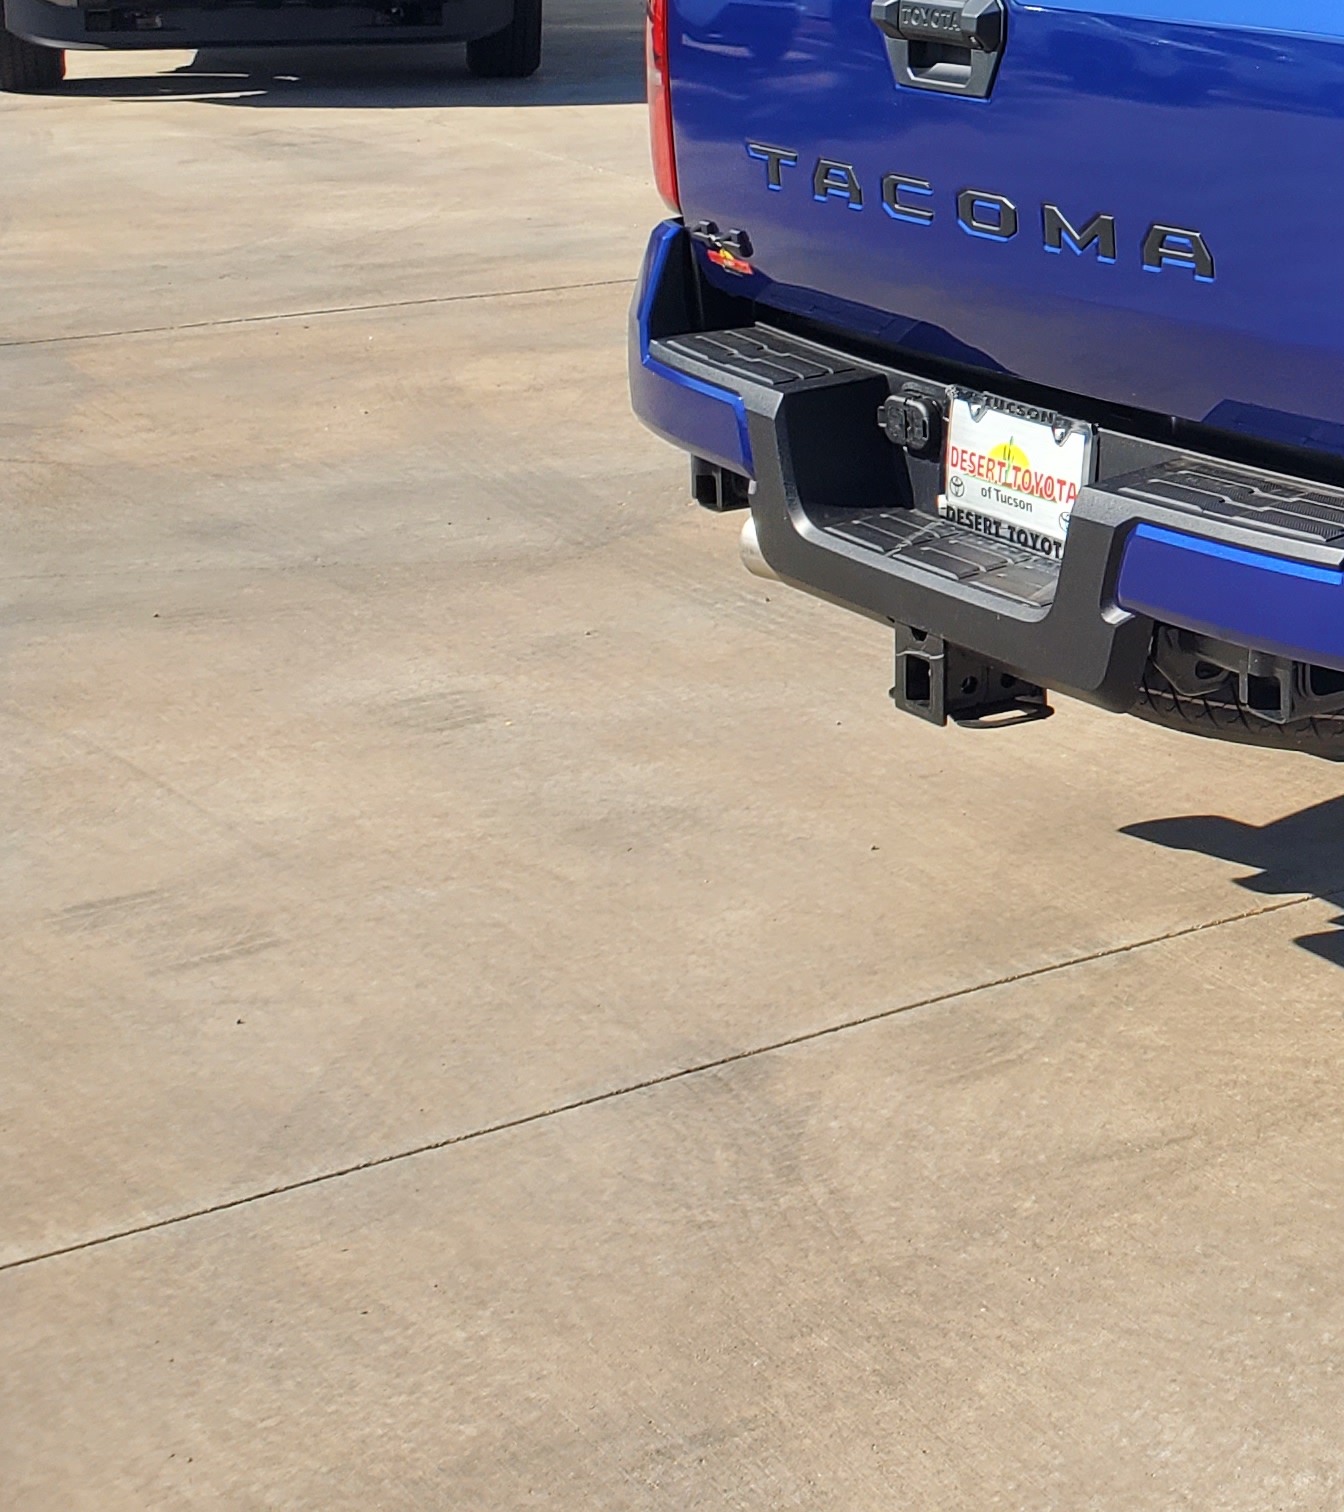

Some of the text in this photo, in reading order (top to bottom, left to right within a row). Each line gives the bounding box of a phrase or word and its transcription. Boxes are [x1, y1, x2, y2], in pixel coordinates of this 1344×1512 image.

[901, 5, 961, 32] TOYOTA
[745, 140, 1217, 283] TACOMA
[950, 445, 1079, 504] DESERT TOYOTA
[981, 485, 1033, 513] of Tucson
[945, 505, 1063, 559] DESERT TOYOT
